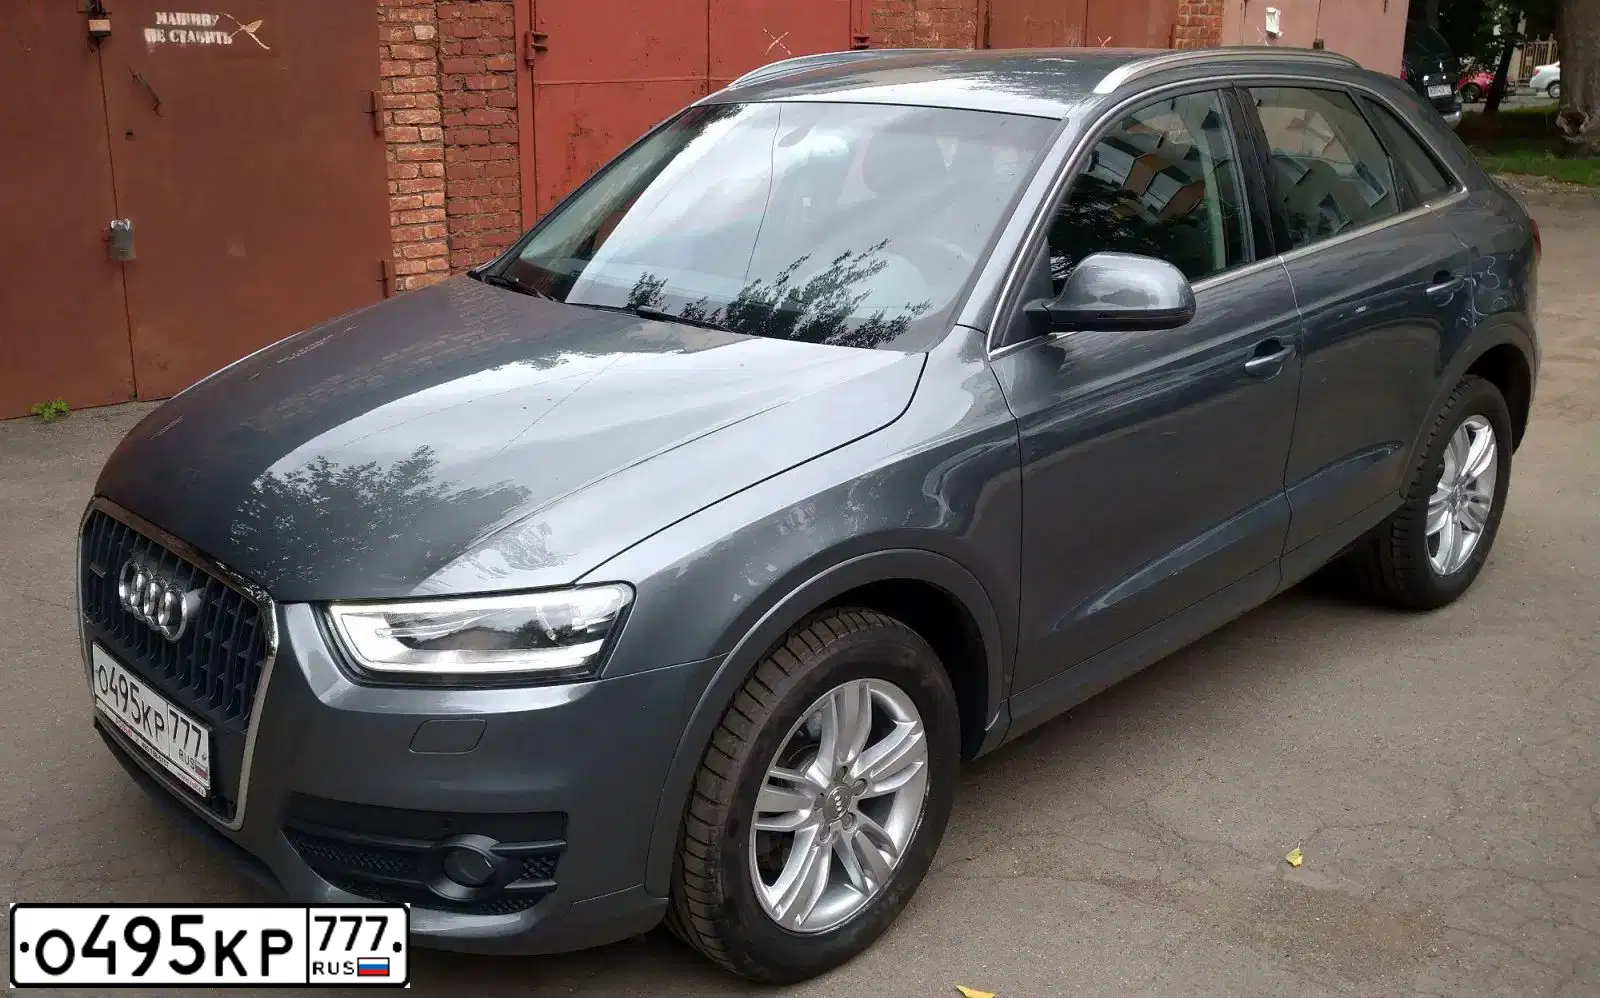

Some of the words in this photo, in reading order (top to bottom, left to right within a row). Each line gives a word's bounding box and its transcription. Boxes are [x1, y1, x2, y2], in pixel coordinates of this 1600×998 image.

[155, 11, 220, 26] МАШИНУ
[144, 28, 166, 43] НЕ
[169, 29, 233, 45] СТАВИТЬ
[169, 709, 202, 757] 777
[178, 748, 196, 770] RUS
